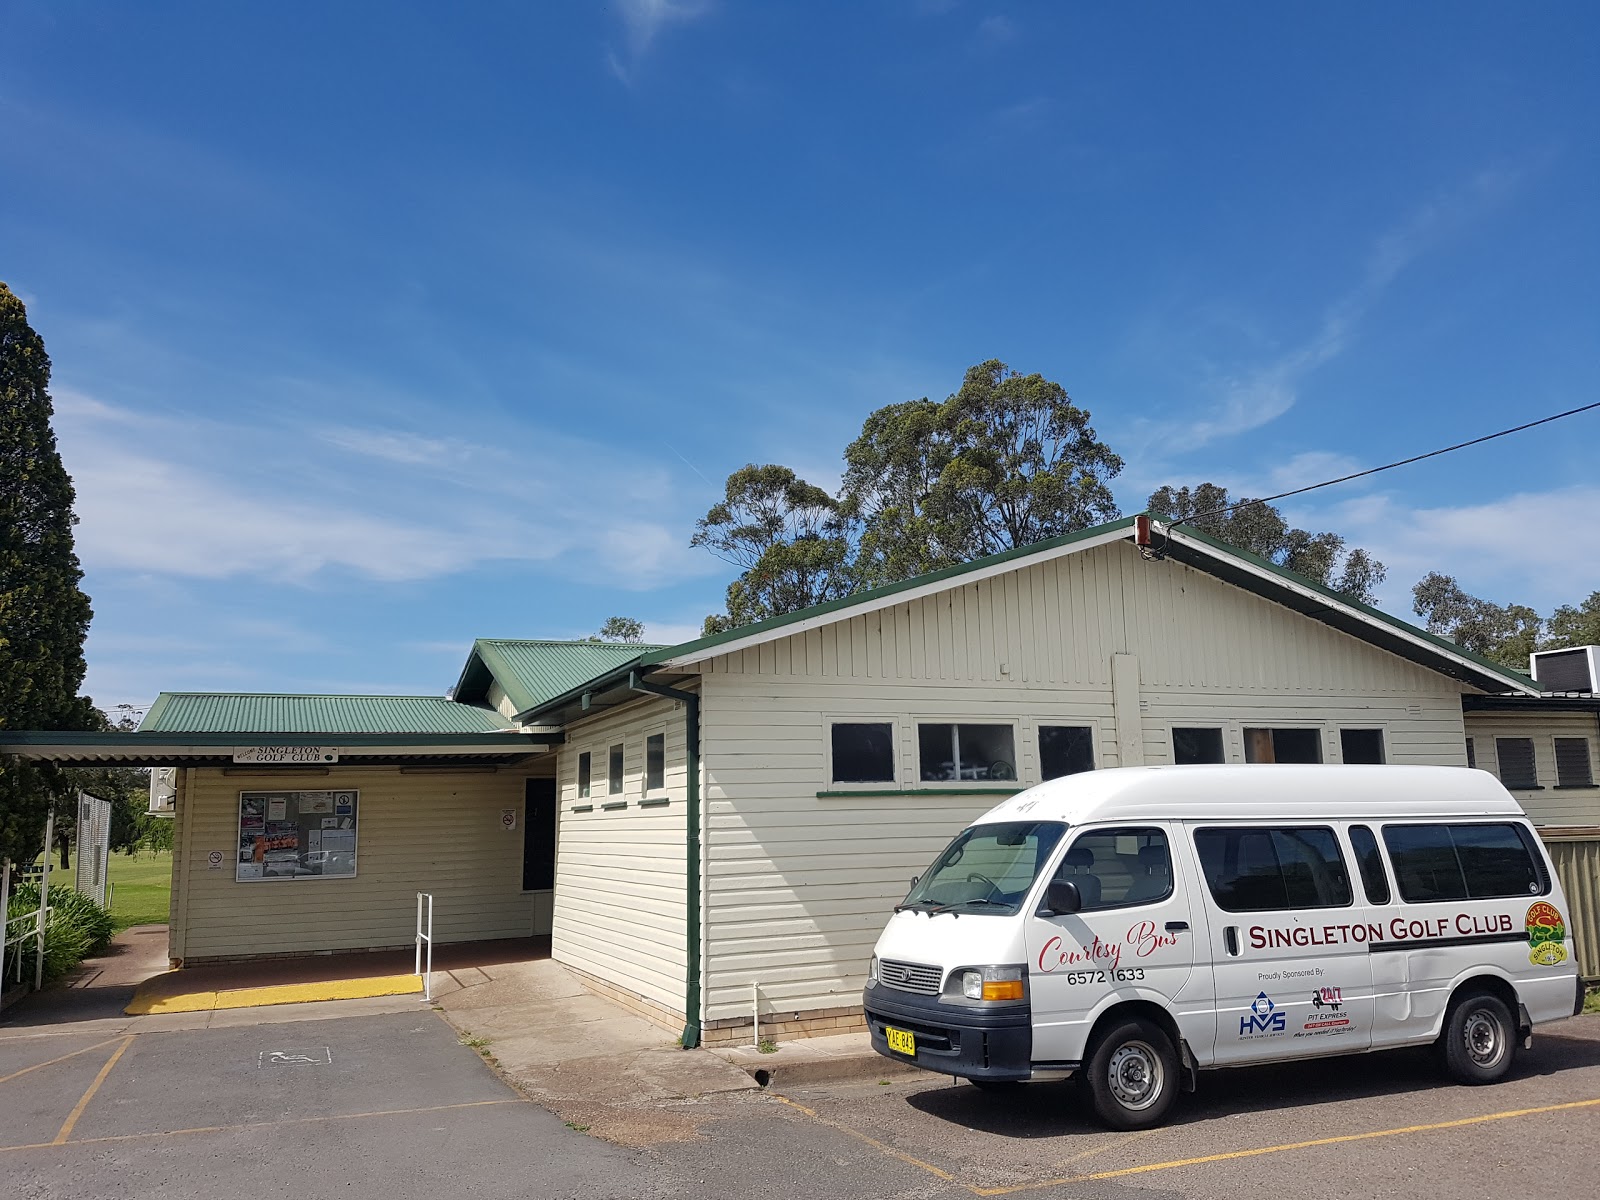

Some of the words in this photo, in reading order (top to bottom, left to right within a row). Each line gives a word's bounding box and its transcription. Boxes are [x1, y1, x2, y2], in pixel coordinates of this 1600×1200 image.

[257, 746, 321, 754] SINGLETON
[1528, 906, 1541, 922] GOLF
[1542, 905, 1559, 920] CLUB
[1249, 923, 1384, 949] SINGLETON
[1389, 918, 1449, 940] GOLF
[1455, 913, 1513, 935] CLUB
[1038, 934, 1123, 973] Courtesy
[1126, 920, 1178, 957] Bus
[1533, 943, 1564, 961] SINGLETON
[1067, 970, 1106, 986] 6572
[1109, 968, 1145, 982] 1633
[1258, 971, 1281, 981] Proudly
[1282, 969, 1314, 979] Sponsored
[1240, 1011, 1286, 1035] HVS
[1320, 1011, 1347, 1020] EXPRESS
